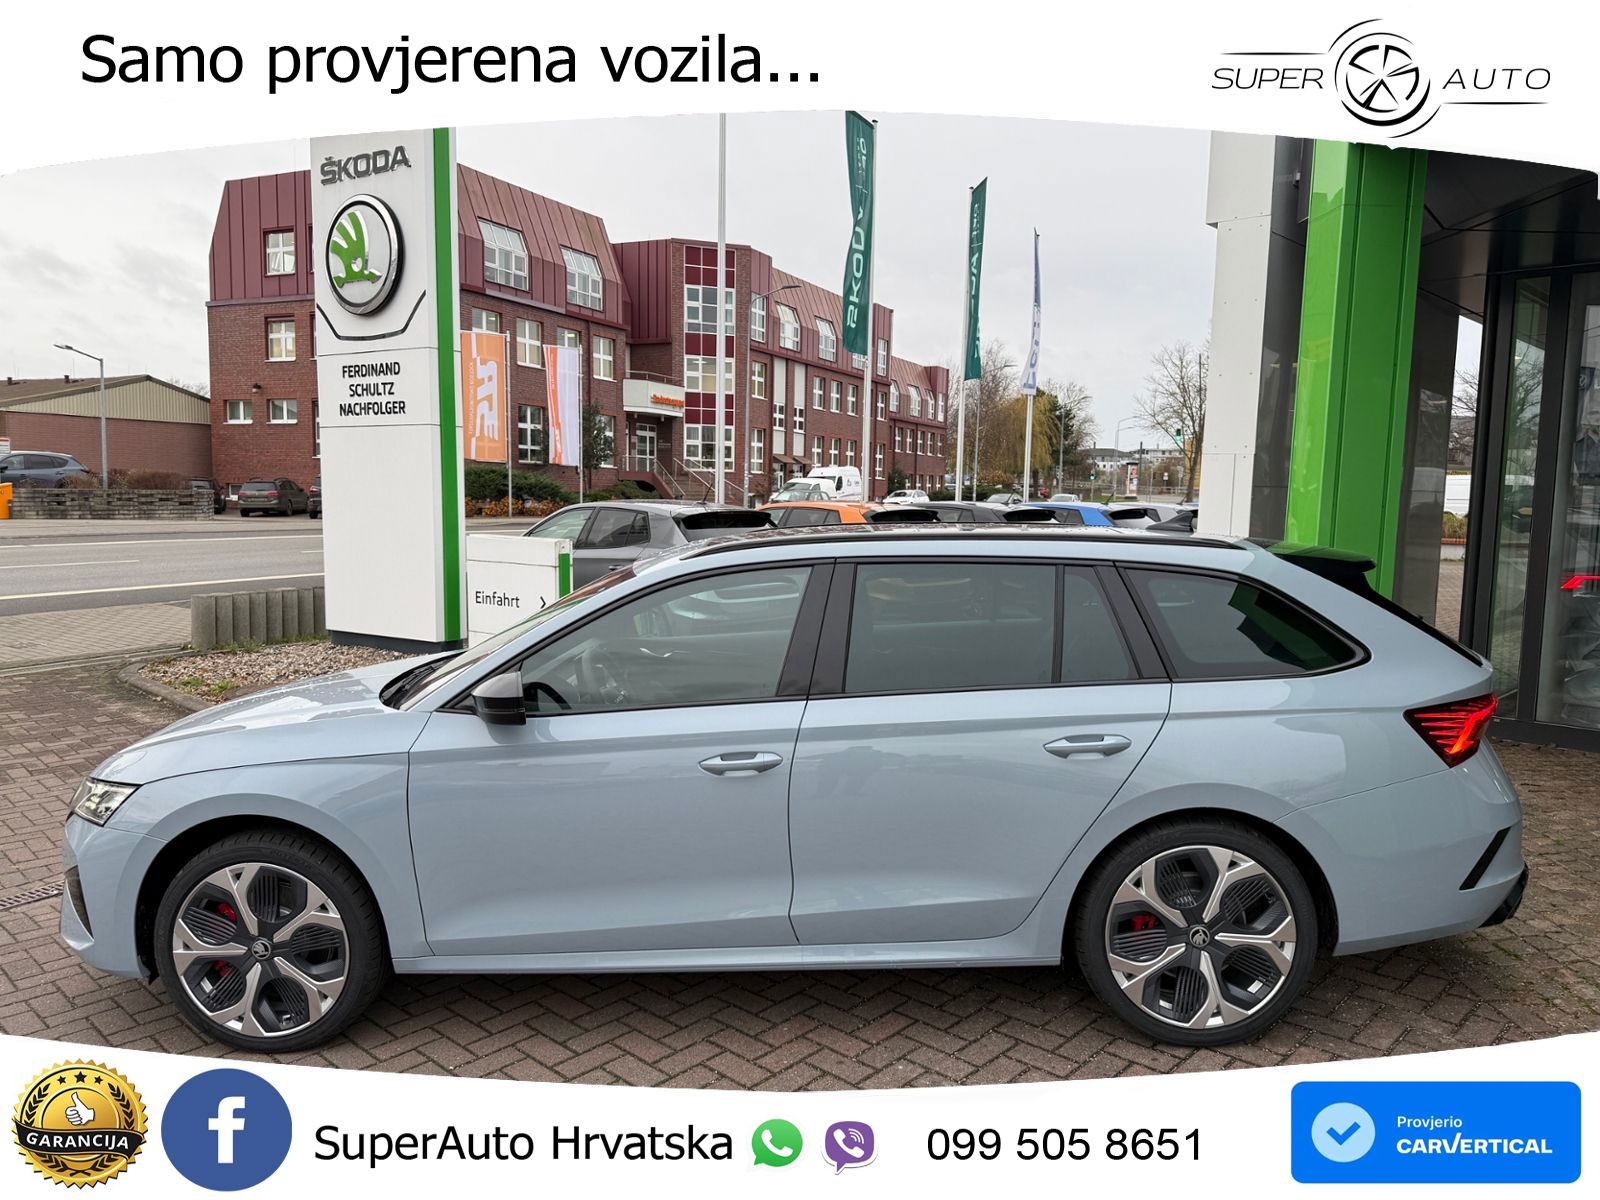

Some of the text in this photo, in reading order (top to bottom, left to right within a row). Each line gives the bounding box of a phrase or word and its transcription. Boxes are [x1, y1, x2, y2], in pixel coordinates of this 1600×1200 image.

[320, 145, 411, 186] ŠKODA
[342, 361, 401, 378] FERDINAND
[348, 381, 395, 398] SCHULTZ
[339, 400, 406, 417] NACHFOLGER
[475, 590, 520, 609] Einfahrt
